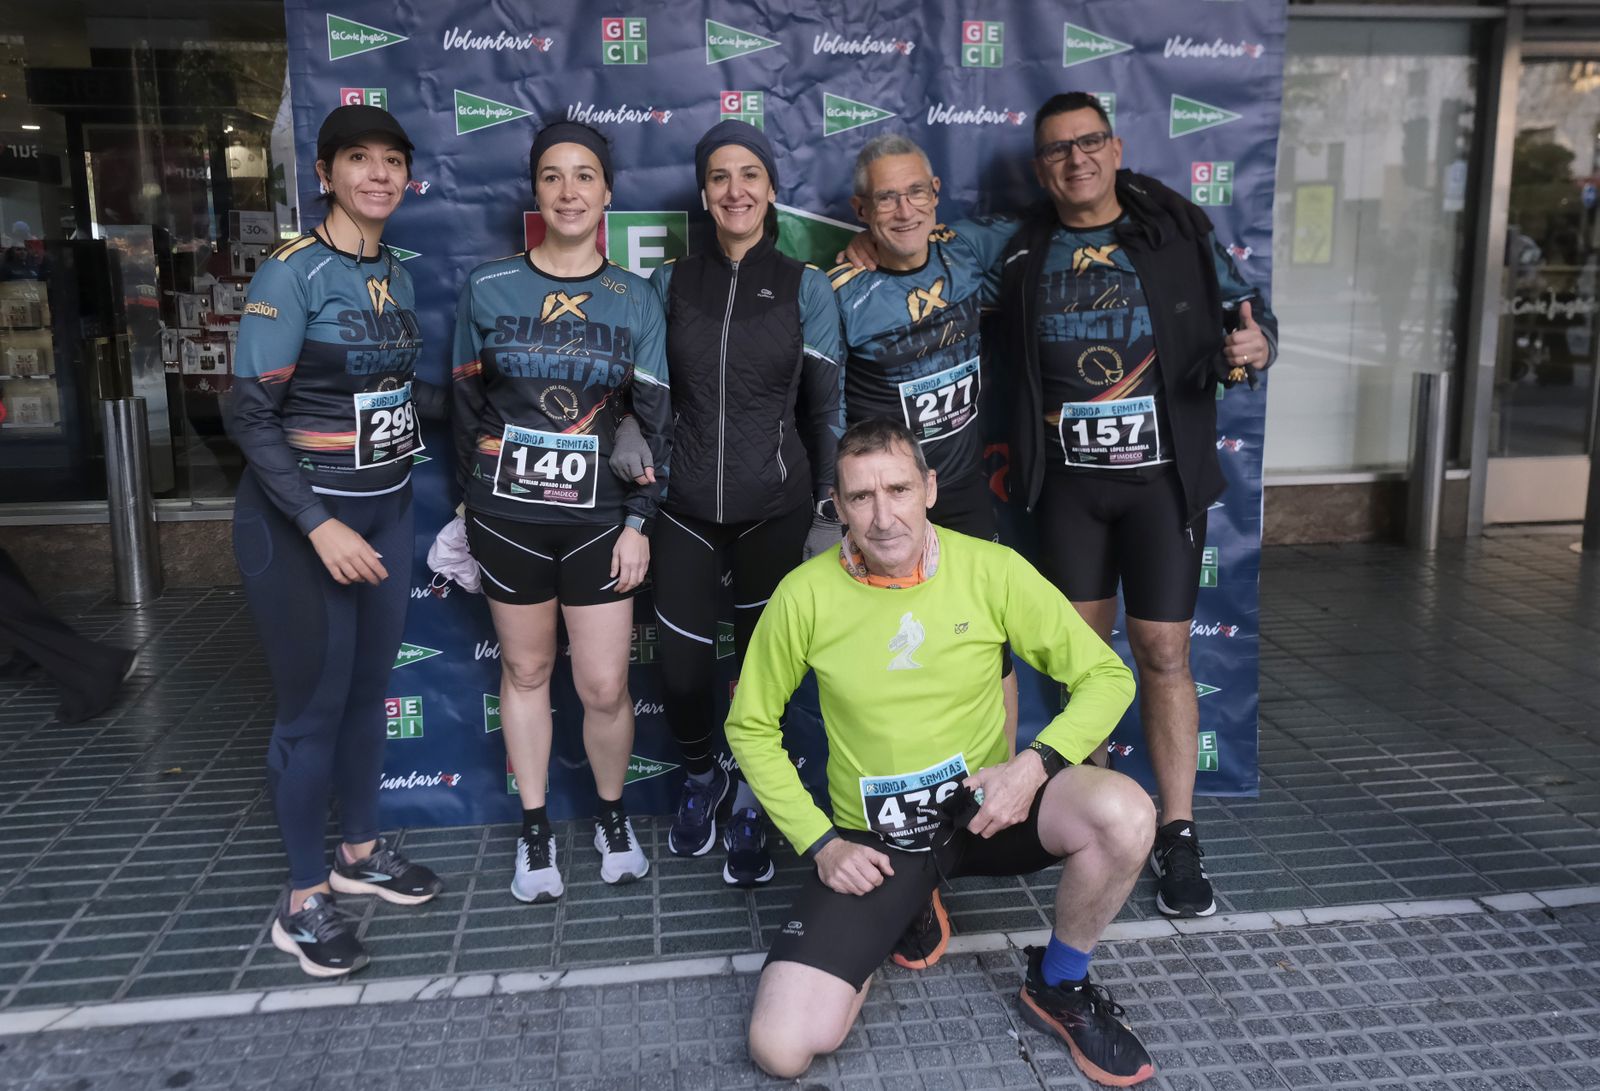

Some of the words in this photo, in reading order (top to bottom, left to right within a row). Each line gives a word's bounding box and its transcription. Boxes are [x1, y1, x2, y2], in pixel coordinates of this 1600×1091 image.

[916, 374, 974, 422] 277
[369, 400, 415, 441] 299
[1071, 414, 1145, 447] 157
[556, 438, 594, 450] ERMITAS
[511, 446, 587, 482] 140
[873, 780, 908, 794] SUBIDA
[920, 761, 962, 787] ERMITAS
